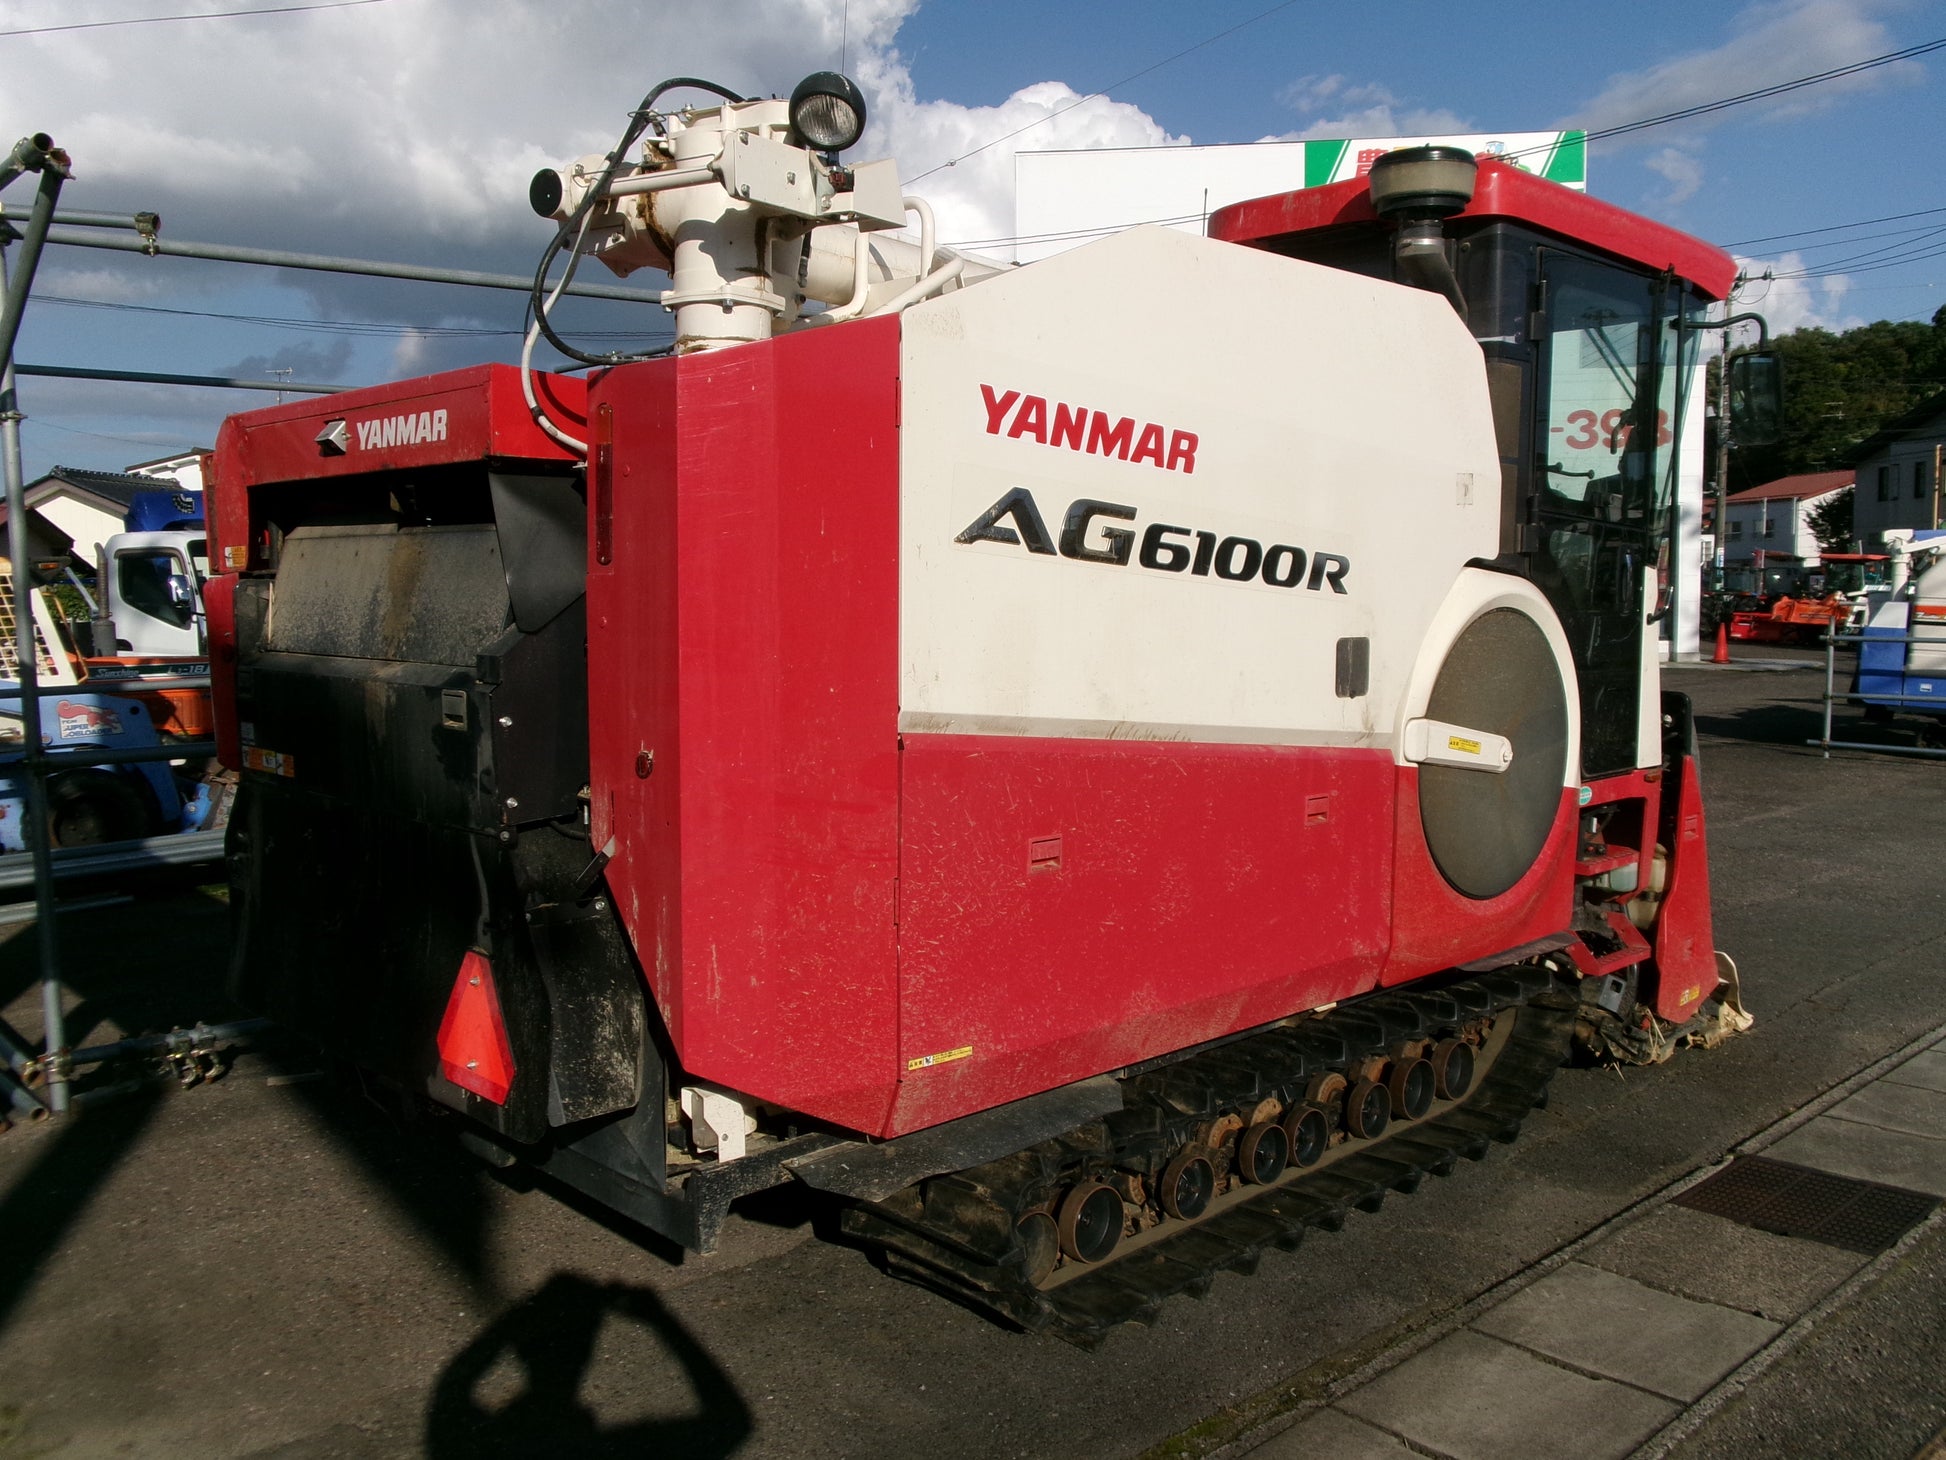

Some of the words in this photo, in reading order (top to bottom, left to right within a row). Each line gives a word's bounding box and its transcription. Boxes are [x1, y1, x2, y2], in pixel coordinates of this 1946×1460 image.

[356, 408, 447, 451] YANMAR
[980, 384, 1199, 474] YANMAR
[953, 486, 1351, 595] AG6100R
